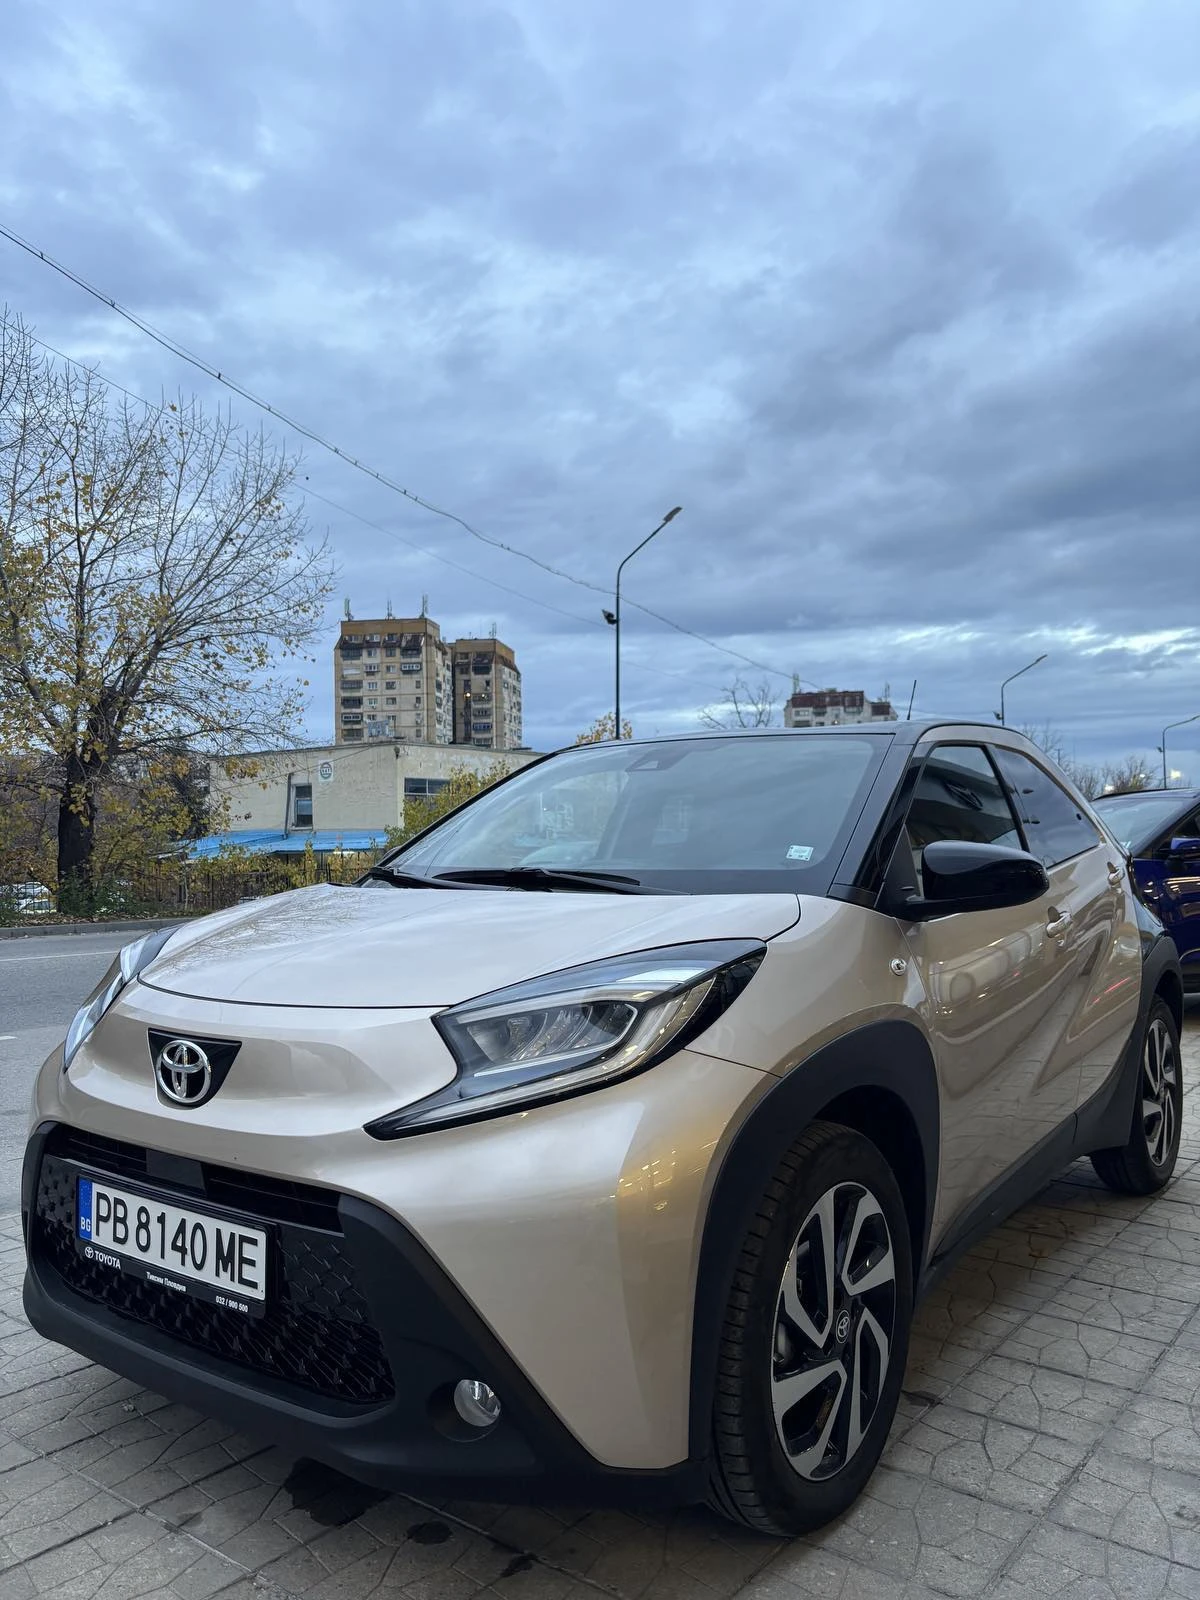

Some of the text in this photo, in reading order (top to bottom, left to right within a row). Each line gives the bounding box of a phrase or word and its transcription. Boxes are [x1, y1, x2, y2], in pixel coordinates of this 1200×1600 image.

[80, 1217, 91, 1232] BG
[95, 1191, 258, 1289] PB 8140 ME
[94, 1250, 121, 1269] TOYOTA
